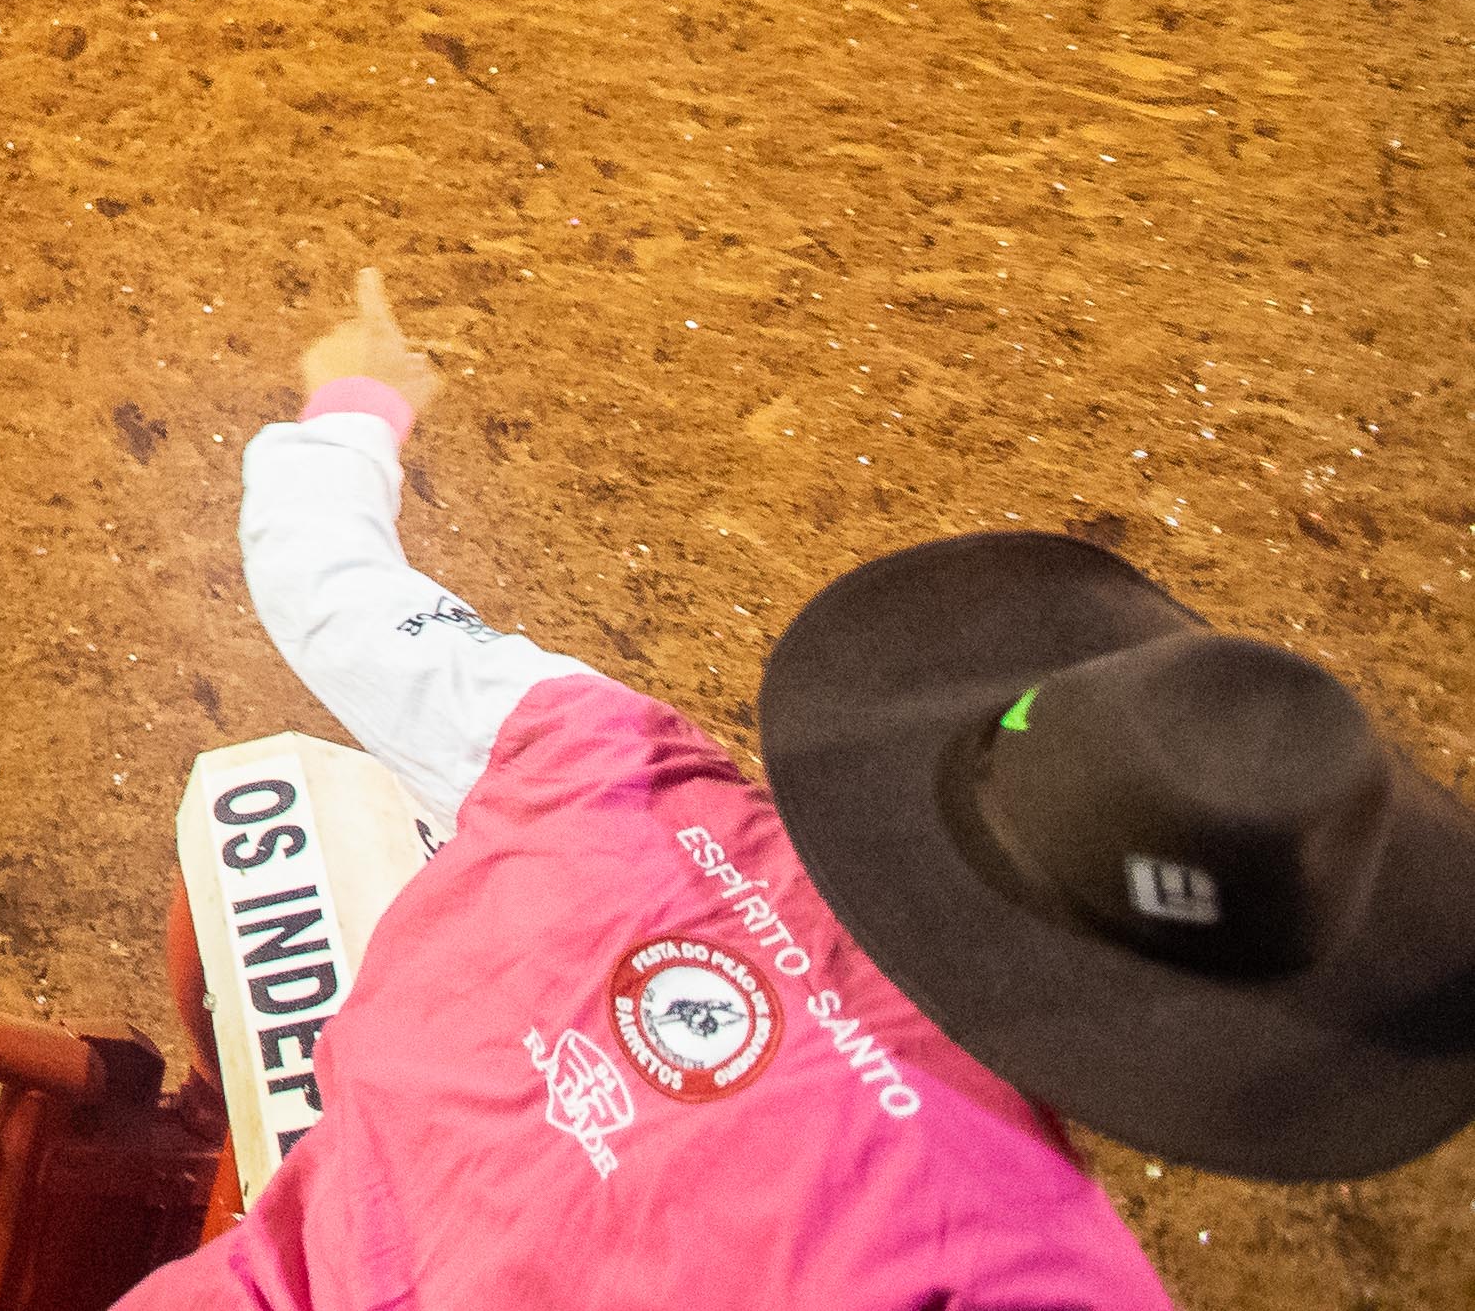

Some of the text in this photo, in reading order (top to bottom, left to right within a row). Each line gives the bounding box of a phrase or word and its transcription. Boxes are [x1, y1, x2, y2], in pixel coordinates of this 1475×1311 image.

[213, 778, 307, 872] OS
[631, 940, 682, 974] FESTA
[680, 941, 710, 962] DO
[676, 825, 922, 1120] ESPÍRITO SANTO
